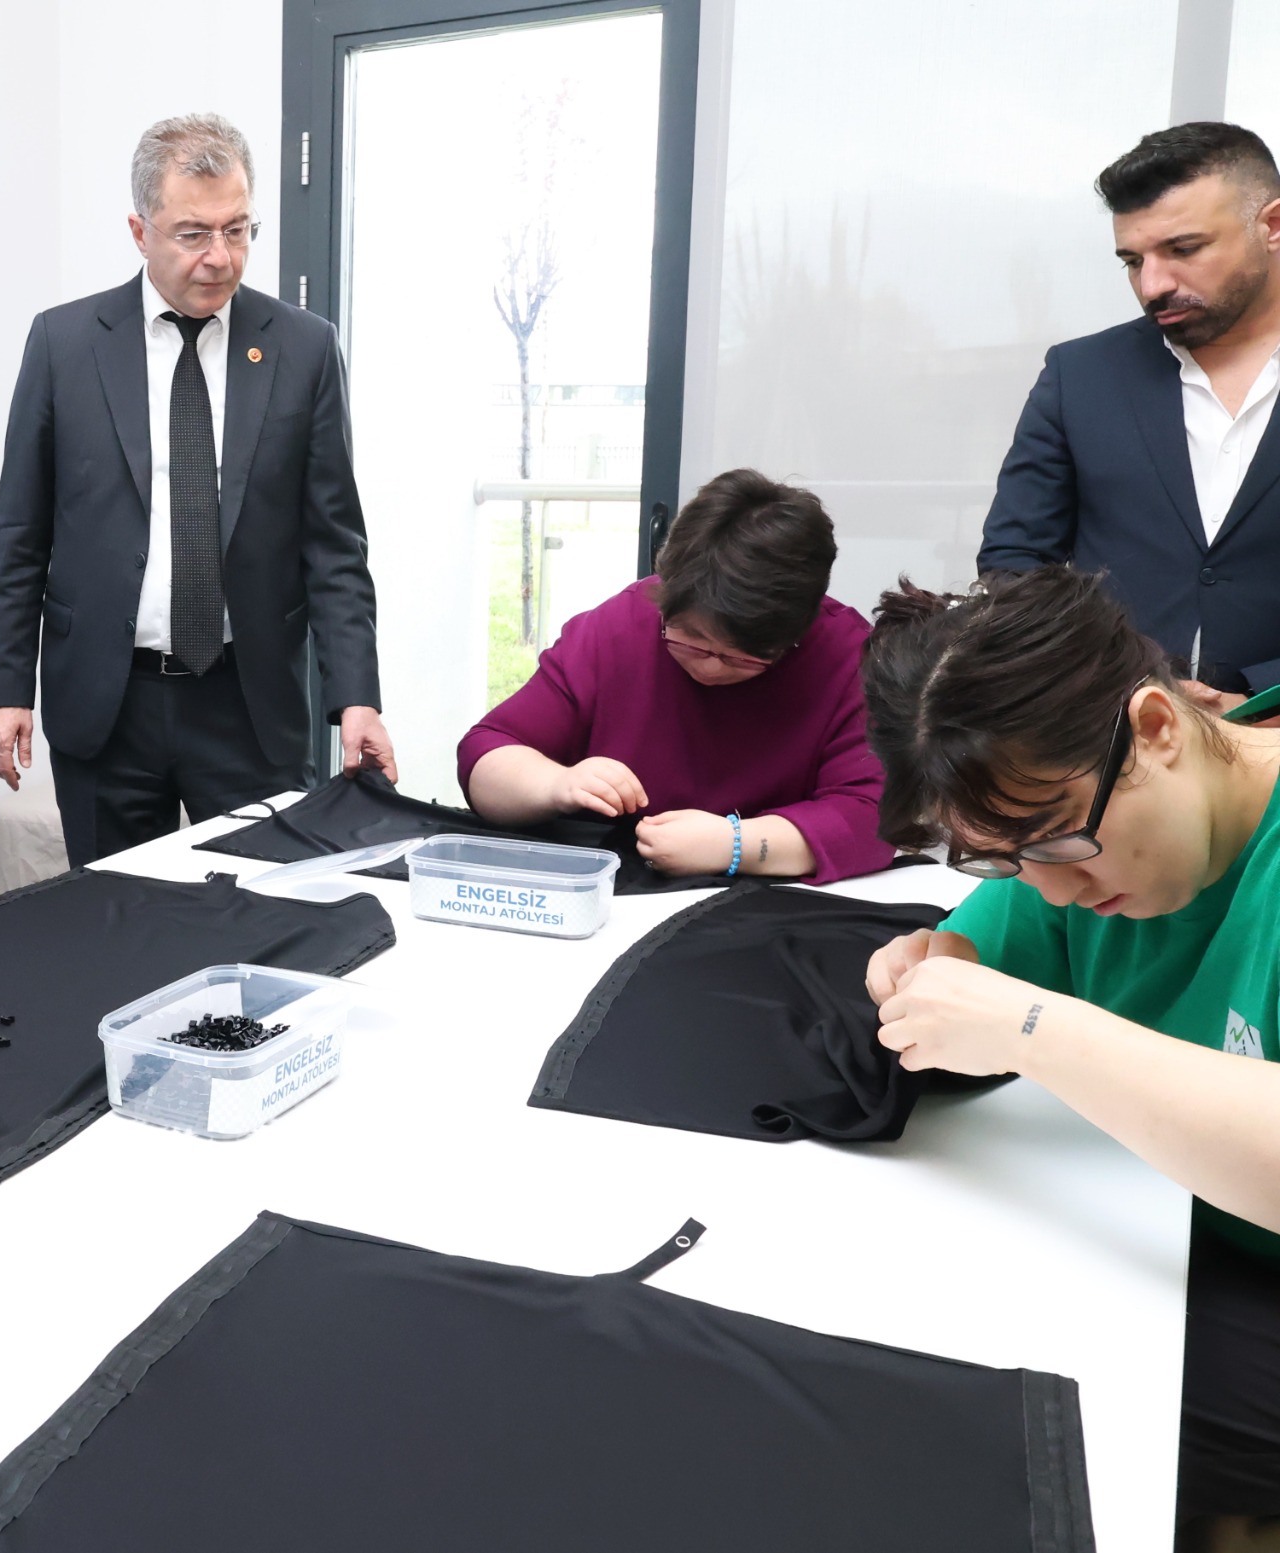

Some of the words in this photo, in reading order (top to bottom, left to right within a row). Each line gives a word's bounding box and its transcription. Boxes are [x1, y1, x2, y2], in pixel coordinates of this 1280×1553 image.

[440, 900, 495, 917] MONTAJ
[499, 908, 563, 925] ATÖLYESİ
[457, 884, 546, 908] ENGELSİZ
[275, 1034, 333, 1084] ENGELSİZ
[261, 1077, 300, 1110] MONTAJ
[302, 1048, 340, 1087] ATÖLYESİ
